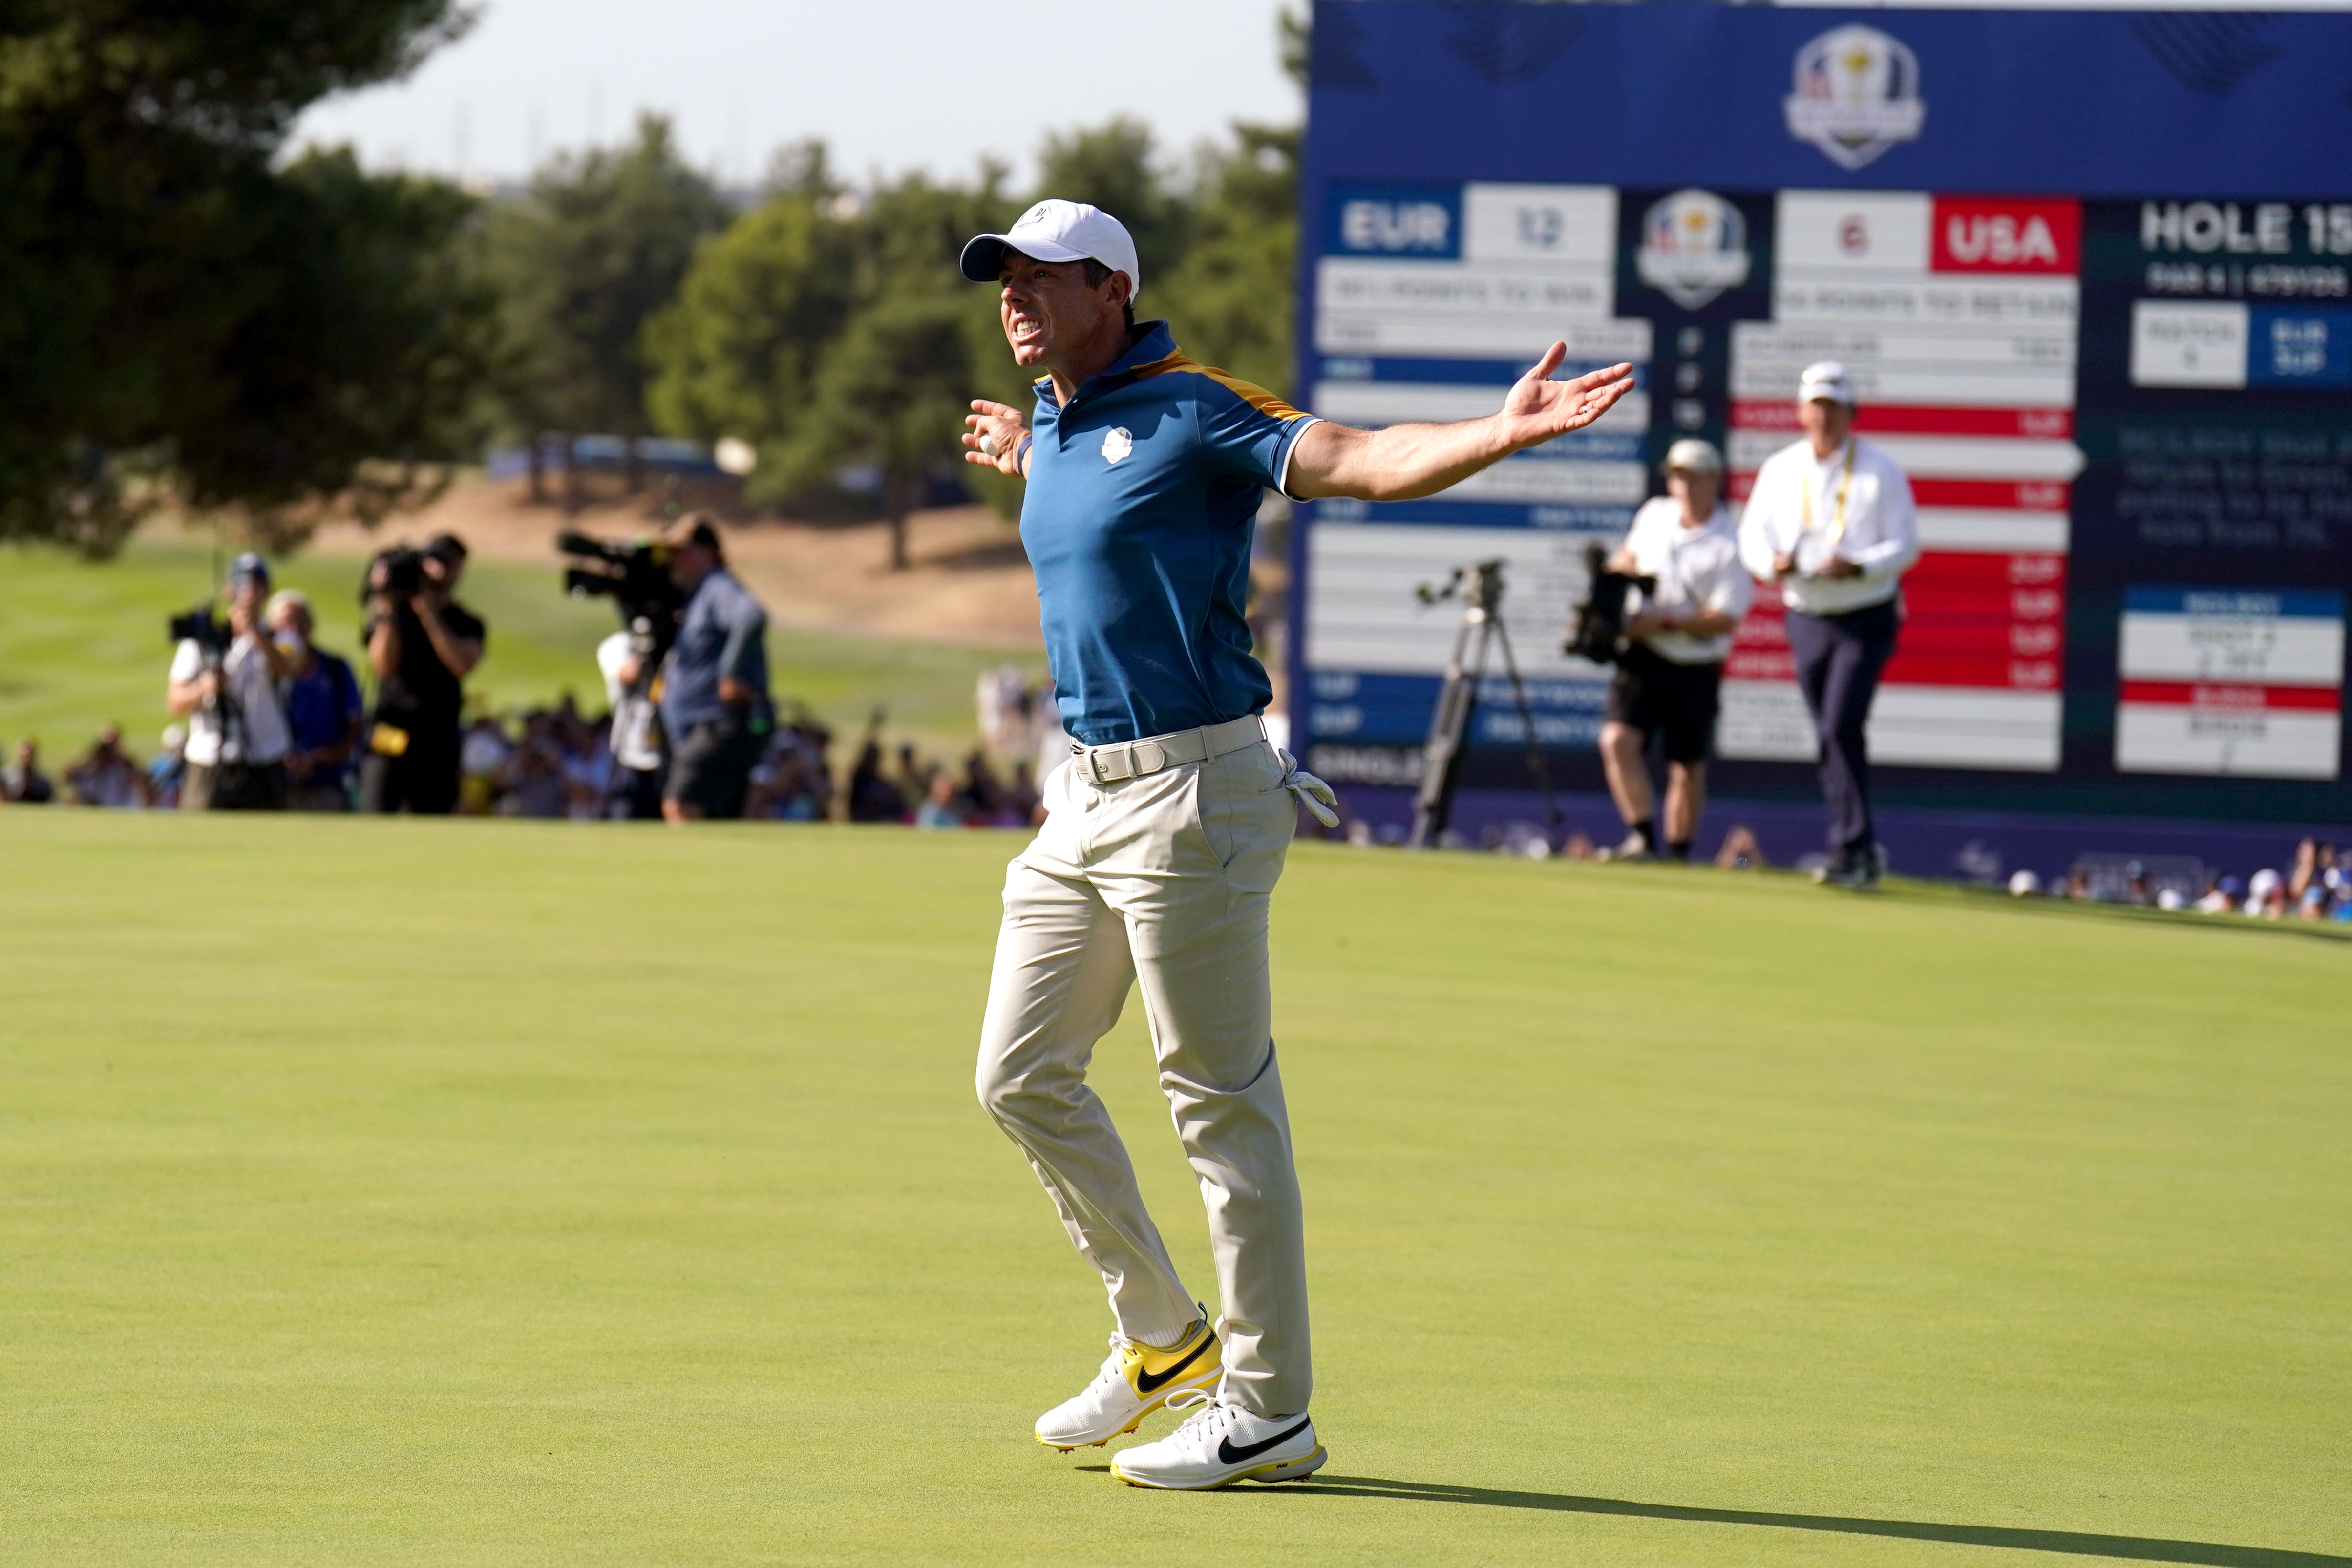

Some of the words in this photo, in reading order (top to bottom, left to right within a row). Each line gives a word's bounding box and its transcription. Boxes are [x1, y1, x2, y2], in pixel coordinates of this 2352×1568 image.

[1340, 201, 1450, 251] EUR
[1514, 207, 1567, 248] 12
[1839, 217, 1869, 257] 6
[1946, 214, 2059, 264] USA
[2141, 202, 2292, 251] HOLE
[1389, 279, 1492, 304] POINTS
[1497, 281, 1535, 305] TO
[2146, 263, 2204, 293] PAR
[1815, 291, 1919, 314] POINTS
[1924, 293, 1961, 316] TO
[1969, 294, 2074, 318] RETAIN
[1308, 745, 1425, 784] SINGLE
